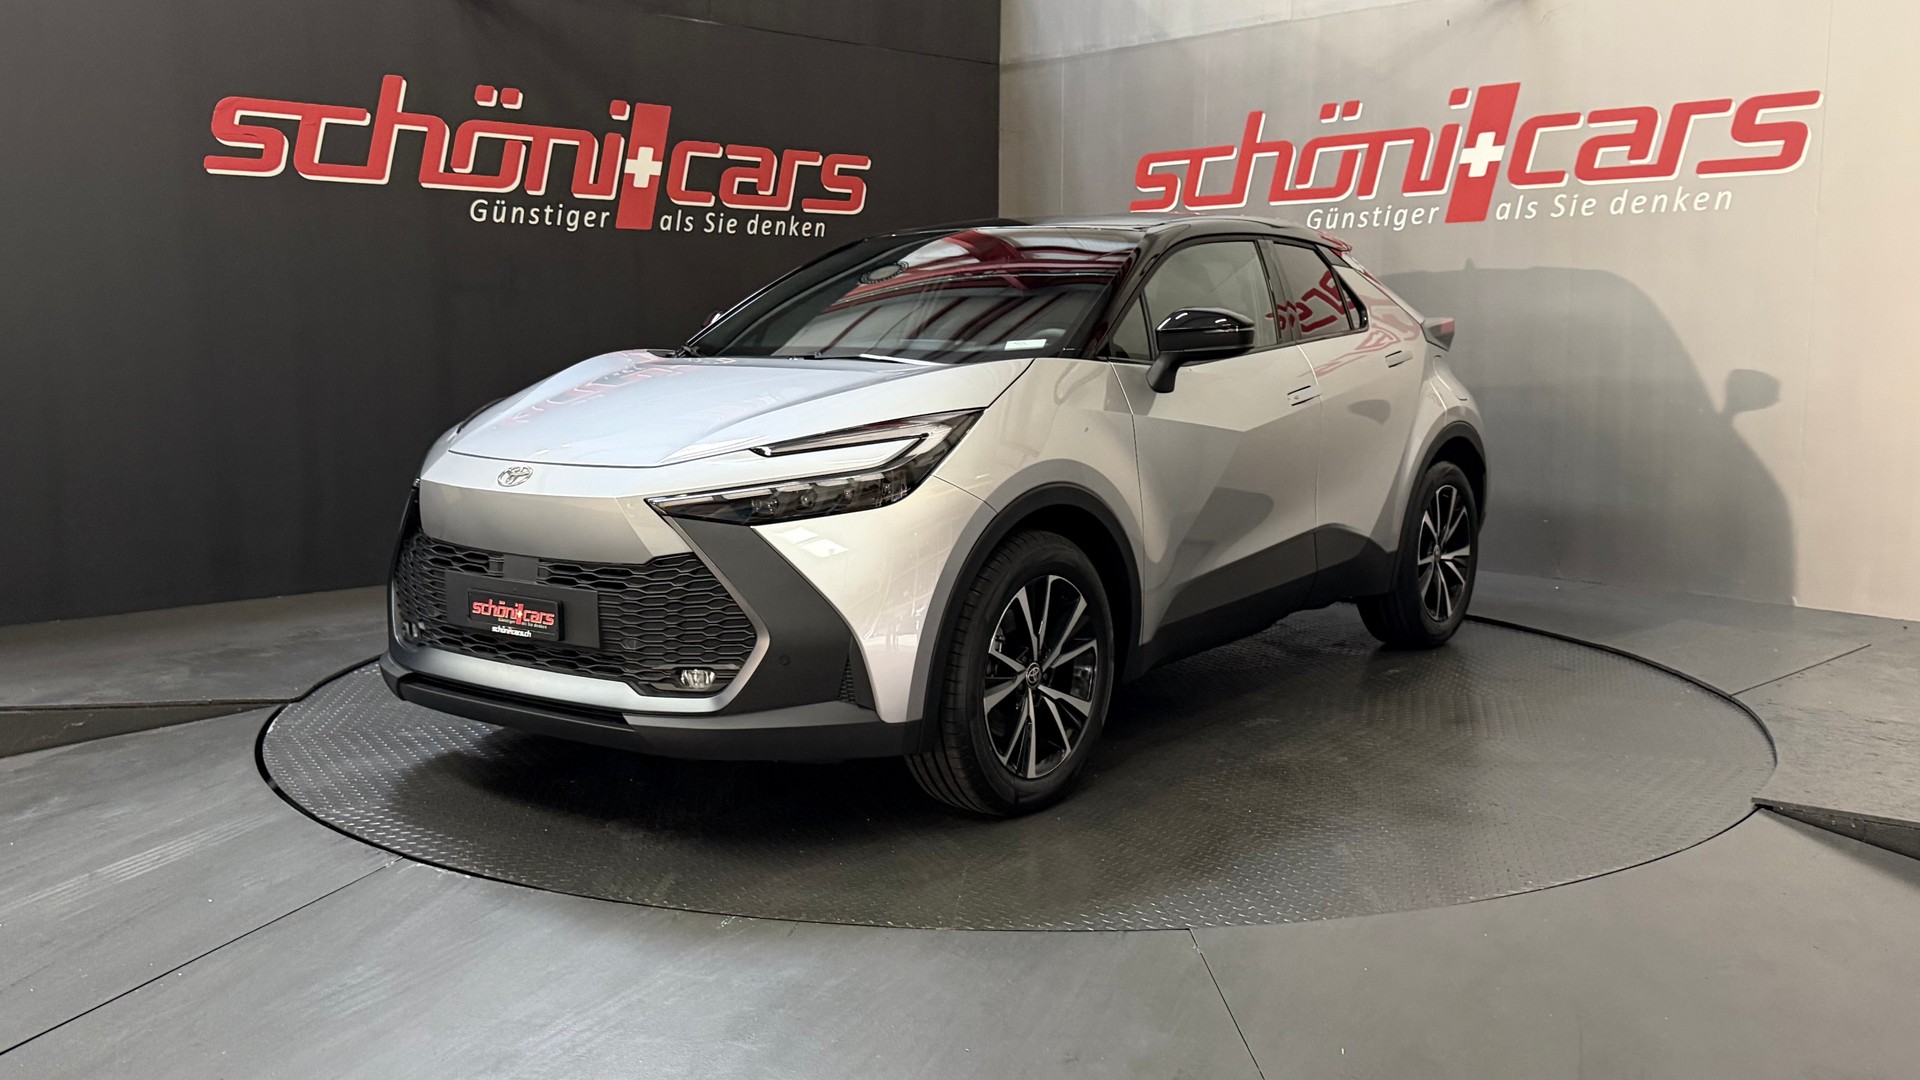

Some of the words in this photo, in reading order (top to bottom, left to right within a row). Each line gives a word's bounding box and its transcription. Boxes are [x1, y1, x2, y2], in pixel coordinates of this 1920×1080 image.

[470, 199, 610, 232] Günstiger
[659, 209, 694, 232] als
[703, 212, 738, 234] Sie
[746, 213, 826, 237] denken
[1306, 203, 1440, 231] Günstiger
[1495, 194, 1538, 221] als
[1550, 193, 1597, 218] Sie
[1609, 186, 1733, 216] denken
